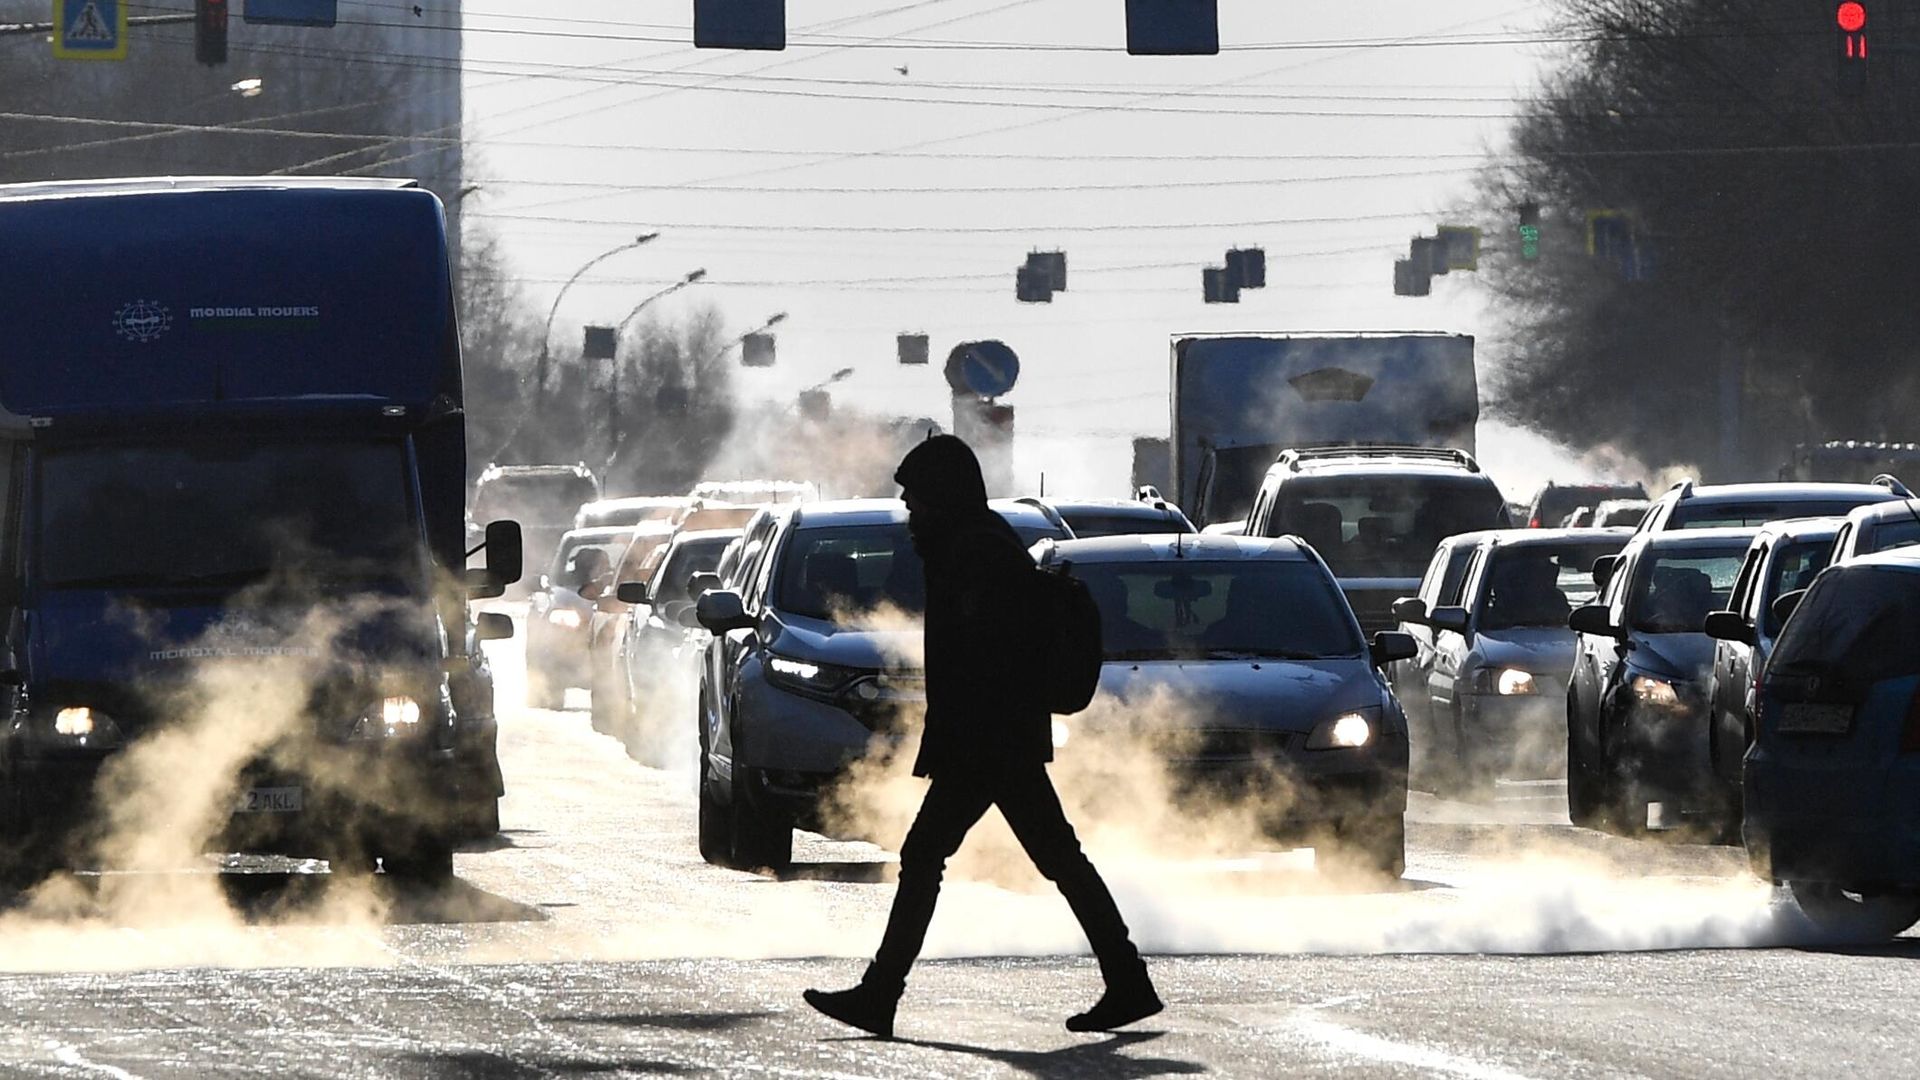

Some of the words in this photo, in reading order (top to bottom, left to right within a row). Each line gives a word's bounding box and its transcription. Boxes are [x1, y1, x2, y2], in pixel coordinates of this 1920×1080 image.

[190, 307, 254, 318] MONDIAL
[257, 306, 320, 317] MOVERS
[150, 648, 237, 660] MONDIAL
